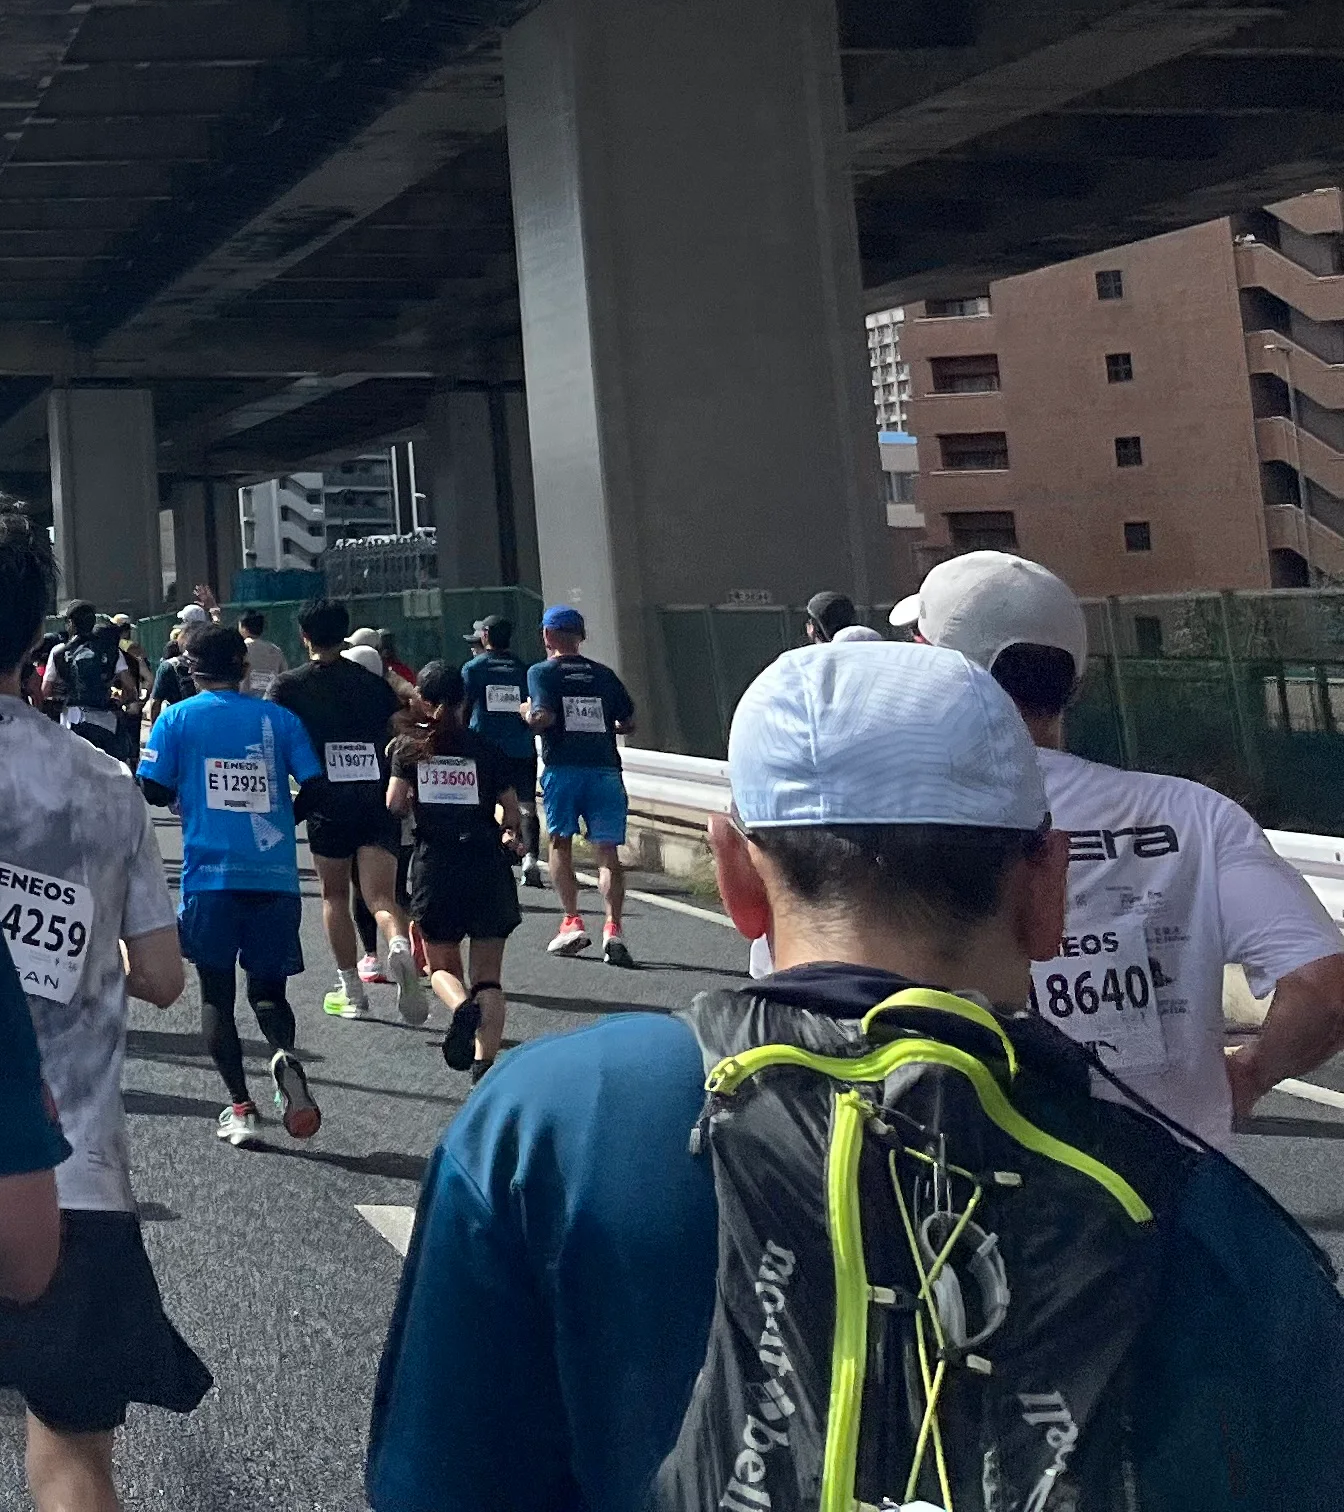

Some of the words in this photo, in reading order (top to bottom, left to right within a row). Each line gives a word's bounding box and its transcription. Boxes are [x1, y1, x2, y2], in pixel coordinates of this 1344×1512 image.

[209, 773, 266, 792] E12925
[1, 903, 86, 957] 4259
[1062, 931, 1119, 957] EOS
[1046, 965, 1149, 1018] 8640
